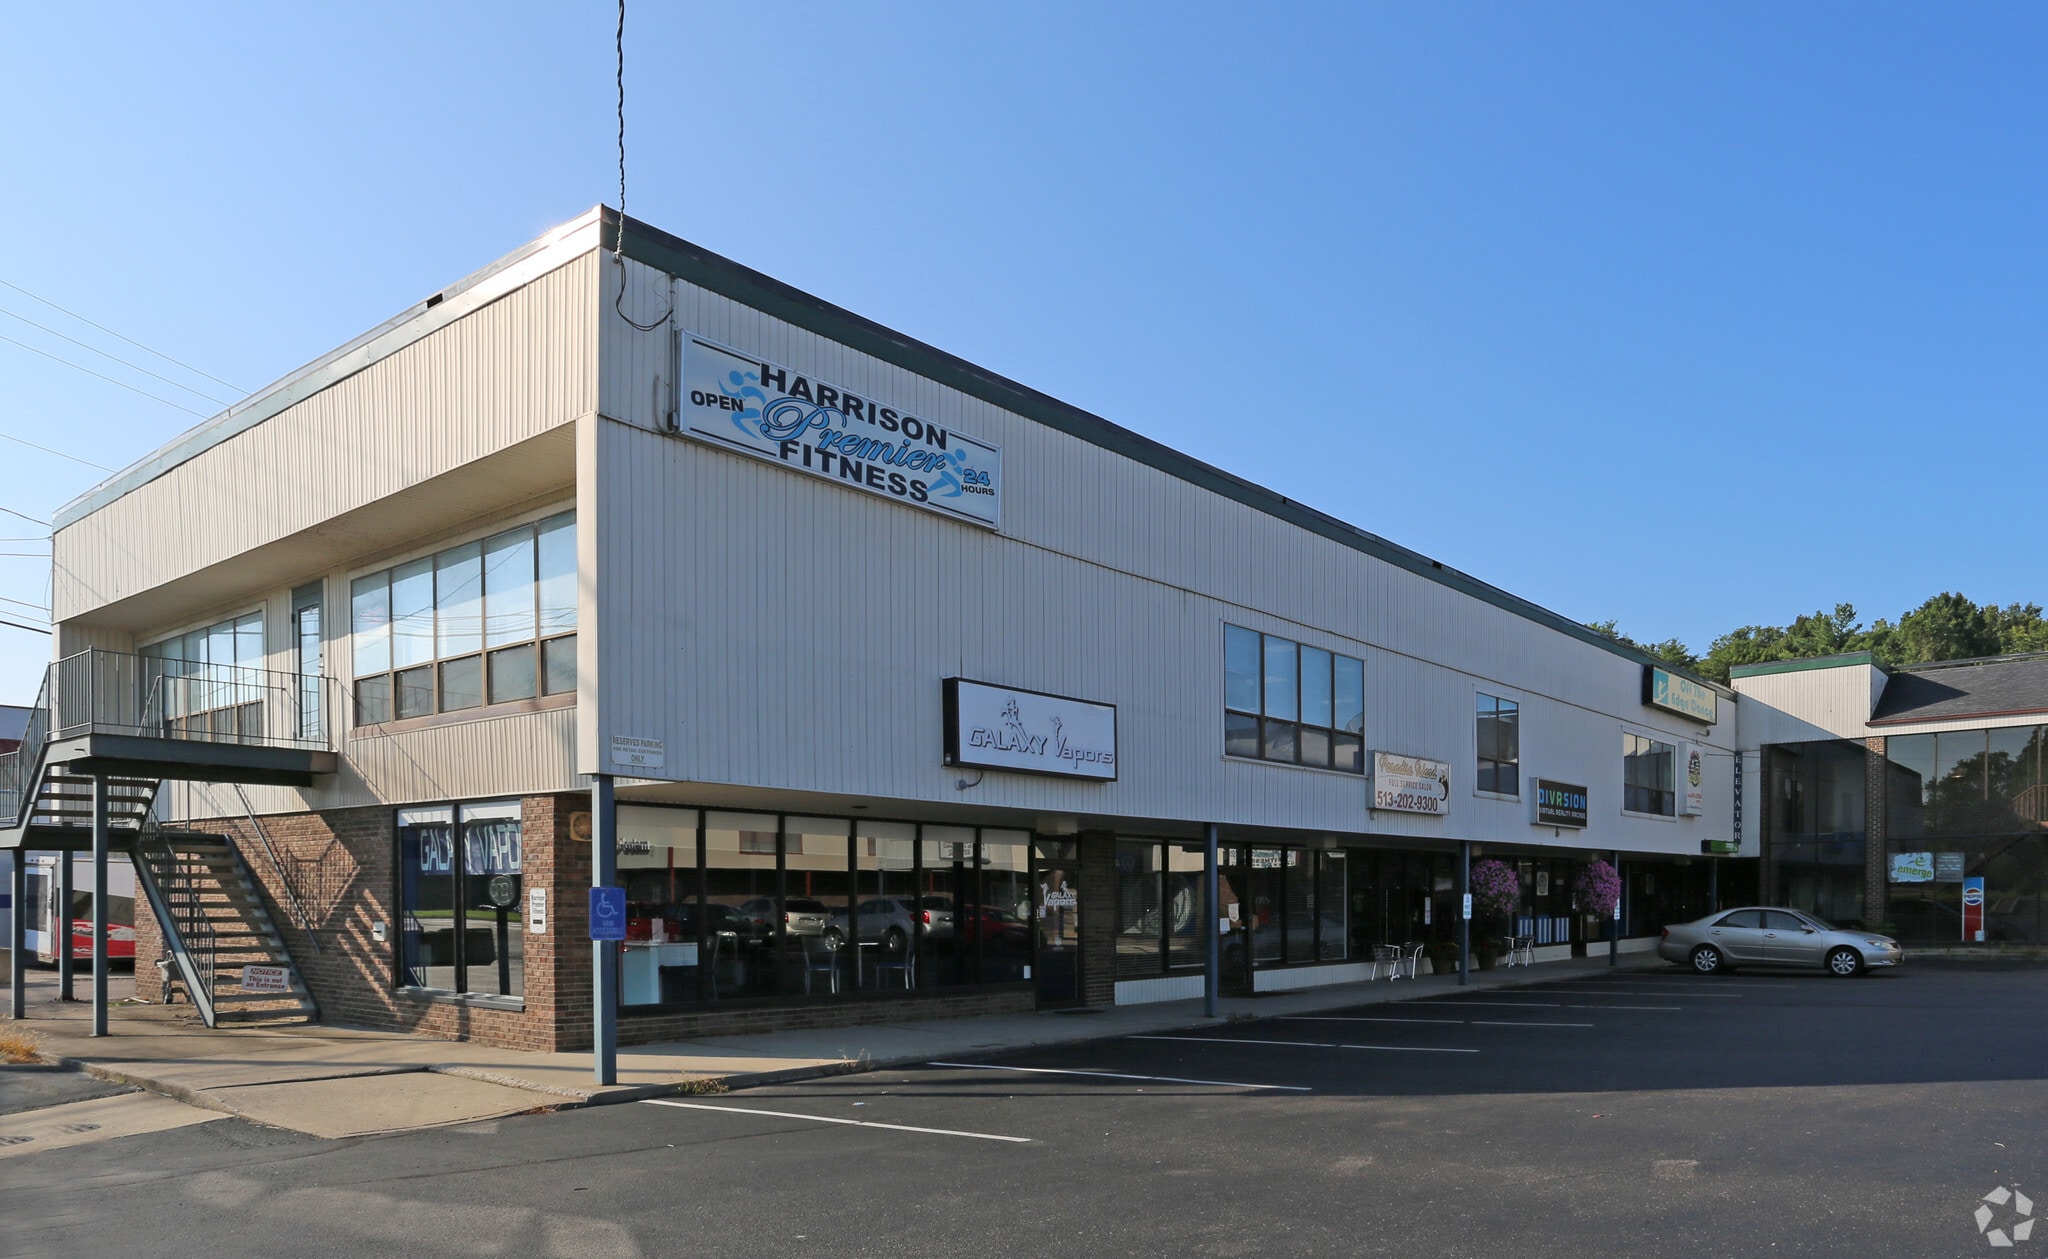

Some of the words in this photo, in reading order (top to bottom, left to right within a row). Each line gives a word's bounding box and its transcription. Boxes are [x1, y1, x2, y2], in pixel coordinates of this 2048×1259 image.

[690, 390, 744, 412] OPEN
[760, 363, 947, 450] HARRISON
[760, 396, 946, 473] Premier
[780, 440, 928, 502] FITNESS
[963, 468, 990, 486] 24
[961, 484, 995, 496] HOURS
[1672, 692, 1689, 711] Edge
[613, 736, 639, 746] RESERVED
[641, 739, 662, 749] PARKING
[968, 726, 1048, 756] GALAXY
[1056, 735, 1114, 769] Vapors
[631, 754, 645, 763] ONLY
[1388, 779, 1399, 788] FULL
[1400, 780, 1418, 790] SERVICE
[1418, 782, 1432, 791] SALON
[1377, 790, 1438, 812] 513-202-9300
[1539, 788, 1586, 809] DIVRSION
[1734, 755, 1742, 840] ELEVATOR
[420, 826, 471, 871] GALAY
[475, 823, 522, 870] VAPO
[1897, 865, 1933, 879] emerge
[251, 967, 282, 976] NOTICE
